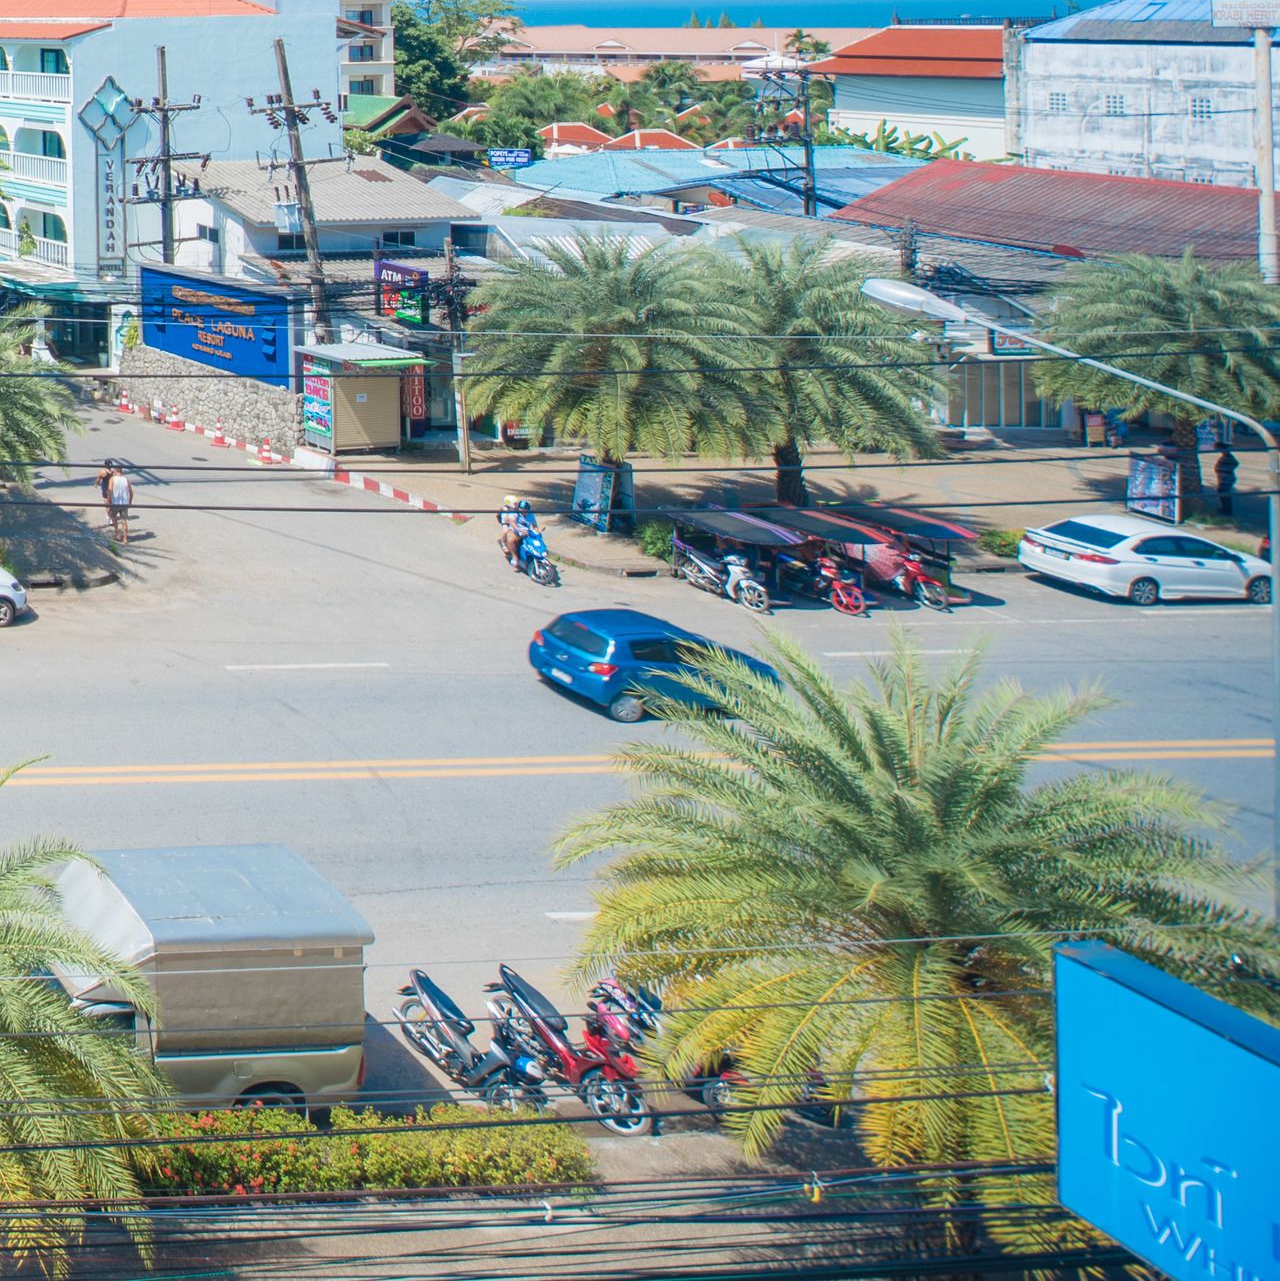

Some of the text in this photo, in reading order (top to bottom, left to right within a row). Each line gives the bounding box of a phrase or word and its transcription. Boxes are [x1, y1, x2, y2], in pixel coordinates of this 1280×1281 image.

[106, 160, 115, 253] VERANDAH
[381, 269, 402, 284] ATM
[171, 308, 256, 341] PEACE LAGUNA
[197, 330, 225, 347] RESORT
